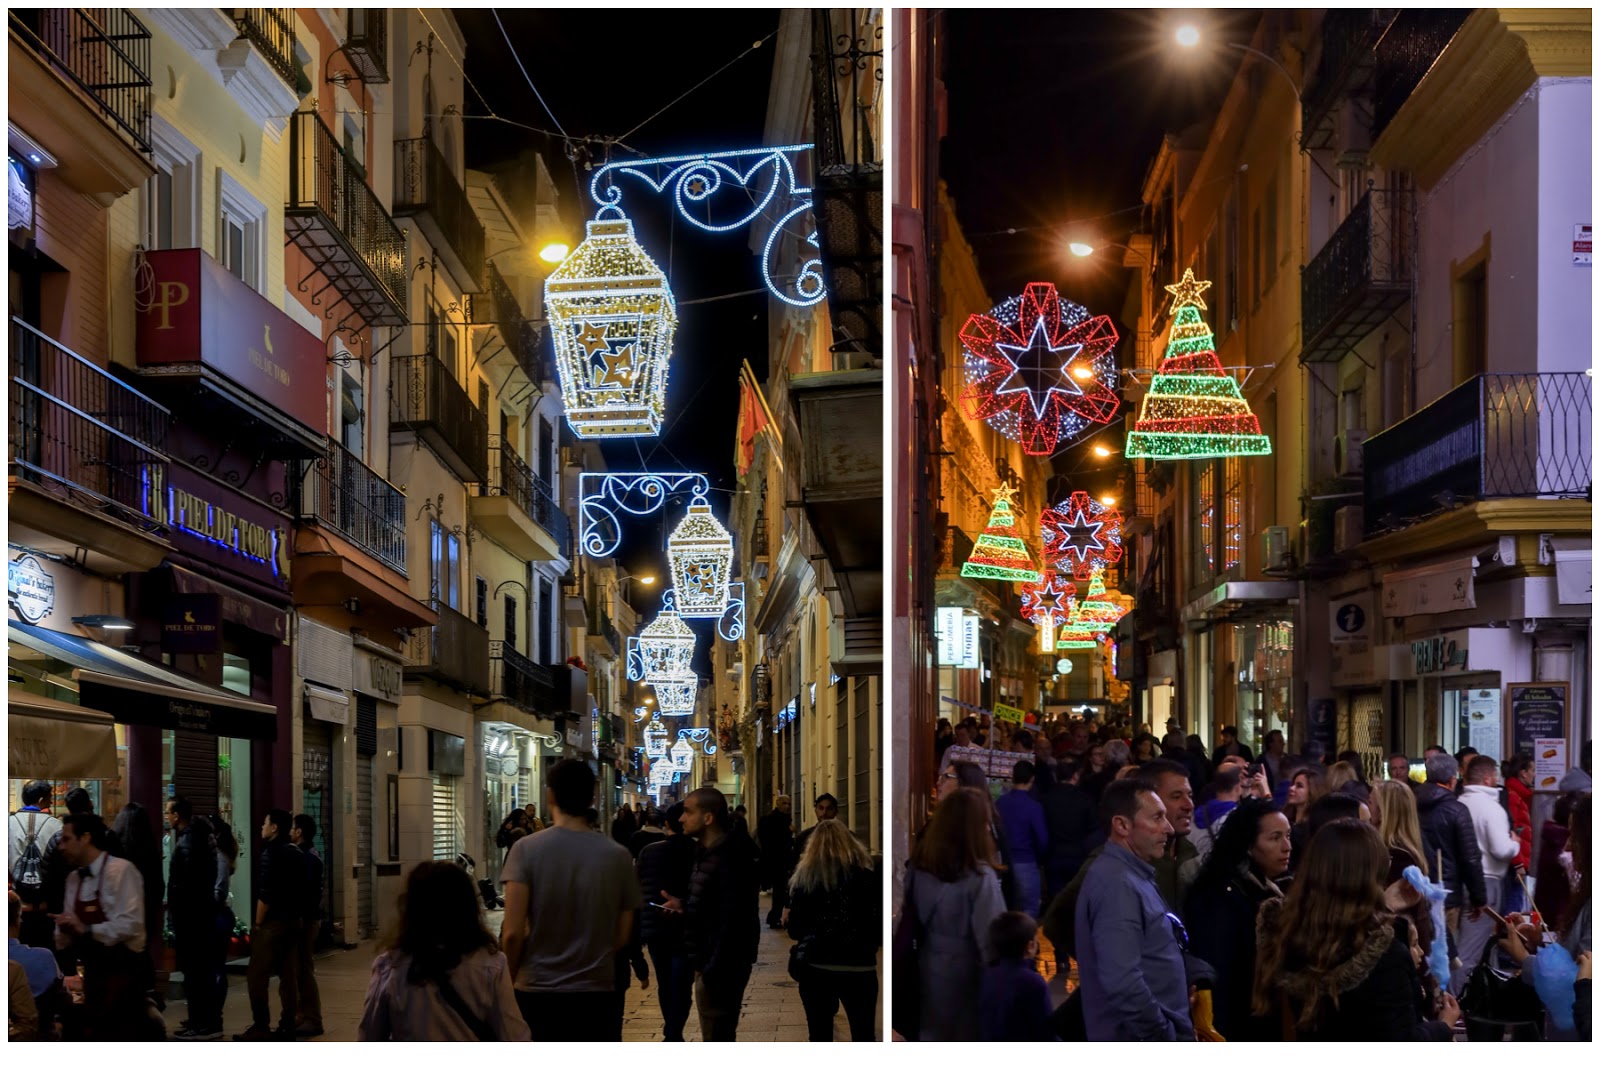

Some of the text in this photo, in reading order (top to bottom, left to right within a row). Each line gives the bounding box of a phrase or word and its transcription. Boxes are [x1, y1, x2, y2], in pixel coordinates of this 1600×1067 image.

[175, 487, 273, 562] PIEL DE TORO
[165, 624, 216, 632] PIEL DE TORO
[996, 706, 1021, 722] ONCE
